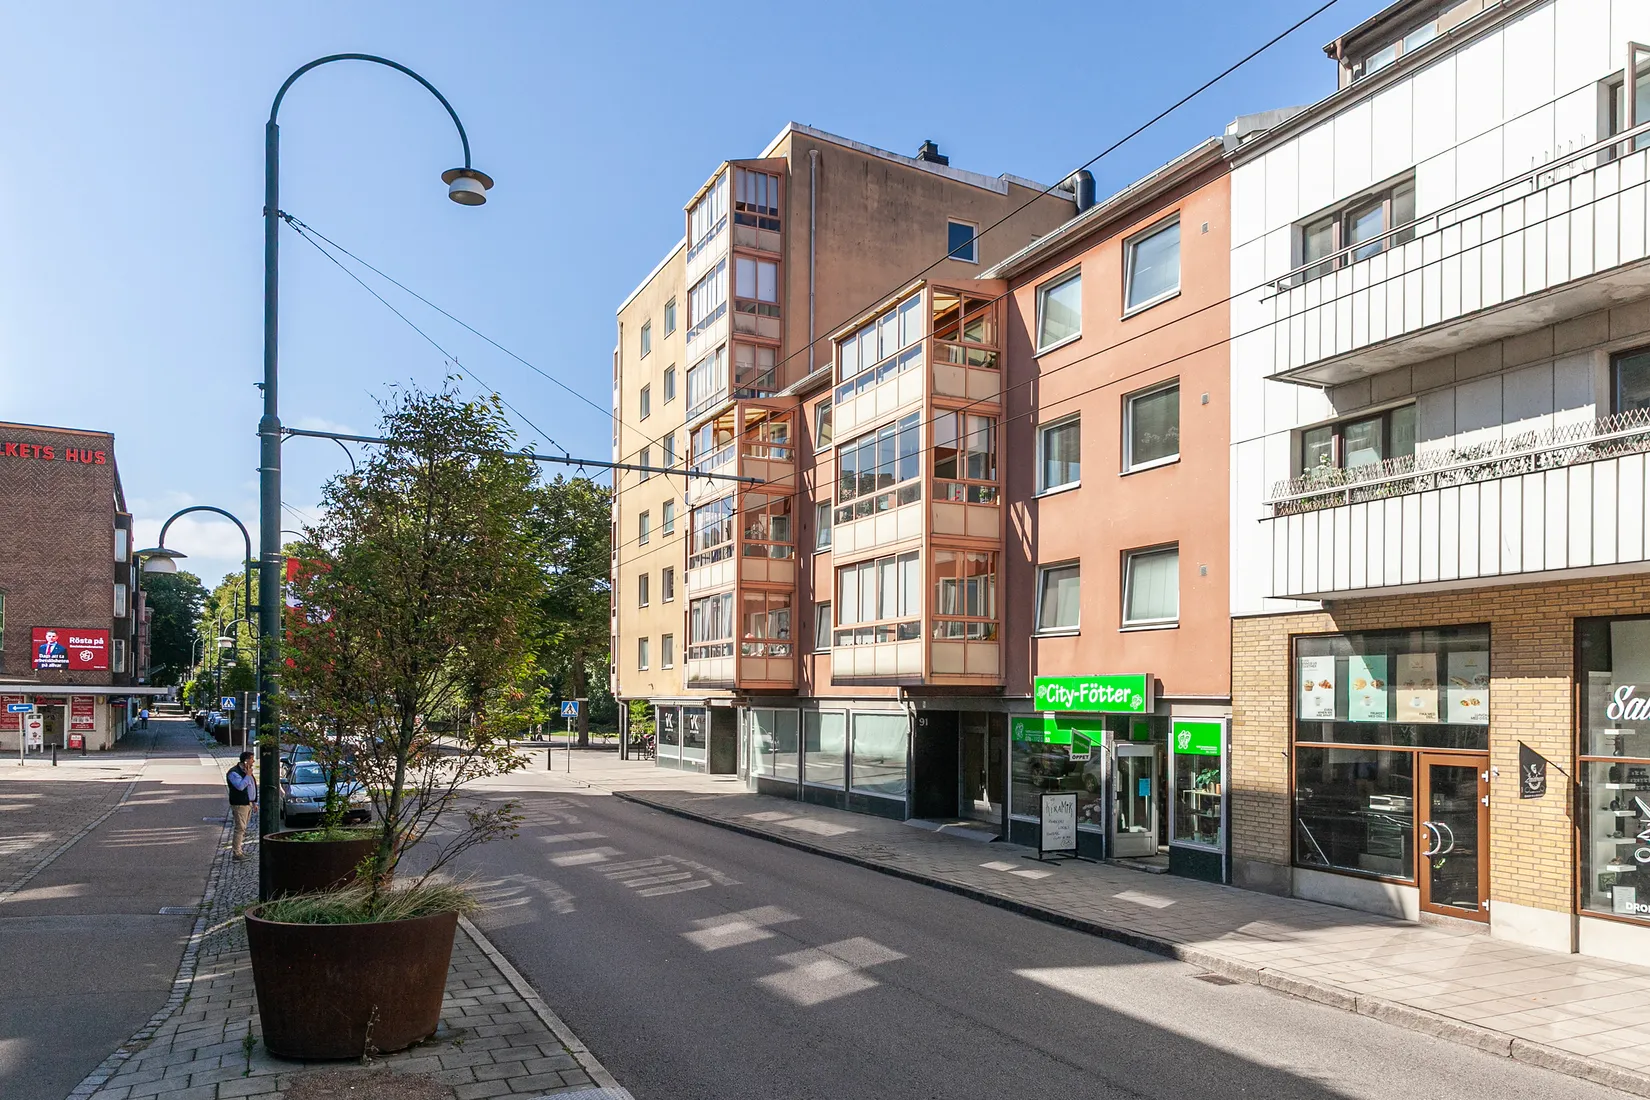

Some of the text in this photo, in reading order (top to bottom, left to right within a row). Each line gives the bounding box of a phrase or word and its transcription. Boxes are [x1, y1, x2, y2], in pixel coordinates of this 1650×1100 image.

[65, 447, 106, 465] HUS
[93, 637, 104, 645] på
[1046, 683, 1131, 708] City-Fötter
[919, 717, 928, 727] 91
